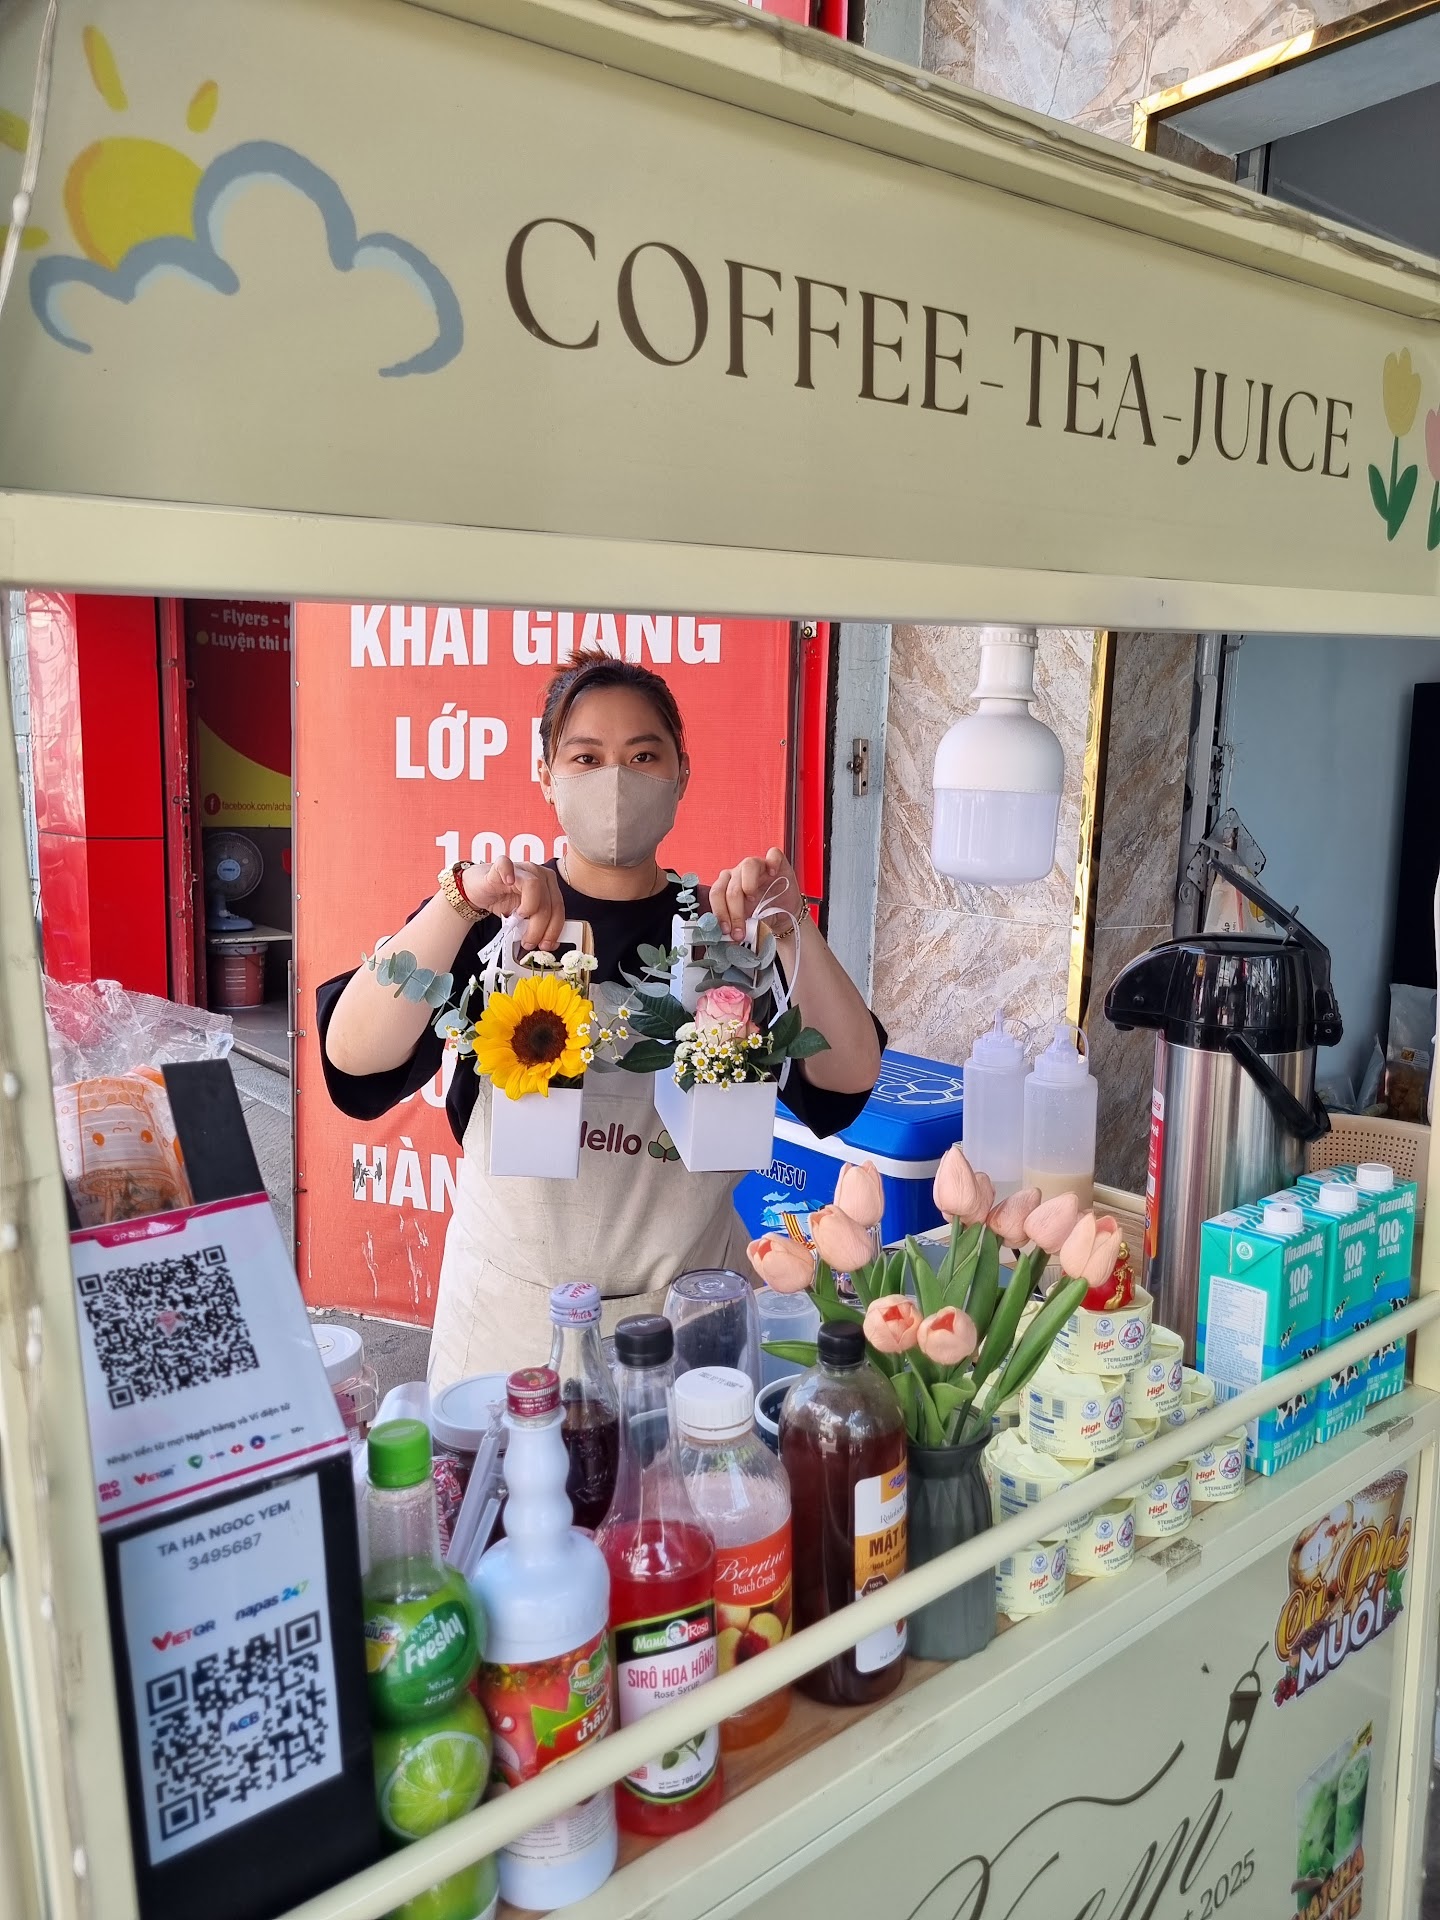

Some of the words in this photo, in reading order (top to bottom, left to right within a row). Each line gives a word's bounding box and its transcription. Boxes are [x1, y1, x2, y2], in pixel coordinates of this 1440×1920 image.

[223, 608, 269, 627] Flyers
[211, 632, 256, 652] Luyện
[259, 635, 279, 651] thi
[350, 604, 489, 667] KHAI
[395, 703, 508, 781] LỚP
[1378, 1190, 1414, 1216] inamilk
[1338, 1211, 1376, 1241] Vinamilk
[1378, 1218, 1405, 1248] 100%
[1093, 1339, 1114, 1351] High
[1103, 1354, 1133, 1363] STERILIZED
[1147, 1383, 1165, 1397] High
[1080, 1421, 1101, 1435] High
[1195, 1469, 1216, 1480] High
[1148, 1502, 1168, 1515] High
[158, 1541, 179, 1557] TA
[182, 1531, 206, 1549] HA
[209, 1513, 255, 1540] NGOC
[258, 1500, 291, 1520] YEM
[188, 1532, 262, 1571] 3495687
[869, 1527, 899, 1558] MẬT
[1094, 1541, 1114, 1555] High
[733, 1578, 756, 1596] Peach
[757, 1569, 776, 1589] Crush
[1029, 1574, 1048, 1590] High
[235, 1594, 280, 1621] napas
[404, 1612, 466, 1675] Freshy
[1296, 1573, 1386, 1696] MUỐI
[627, 1665, 658, 1689] SIRÔ
[662, 1664, 688, 1688] HOA
[227, 1710, 260, 1736] ACB
[1200, 1847, 1255, 1920] 2025
